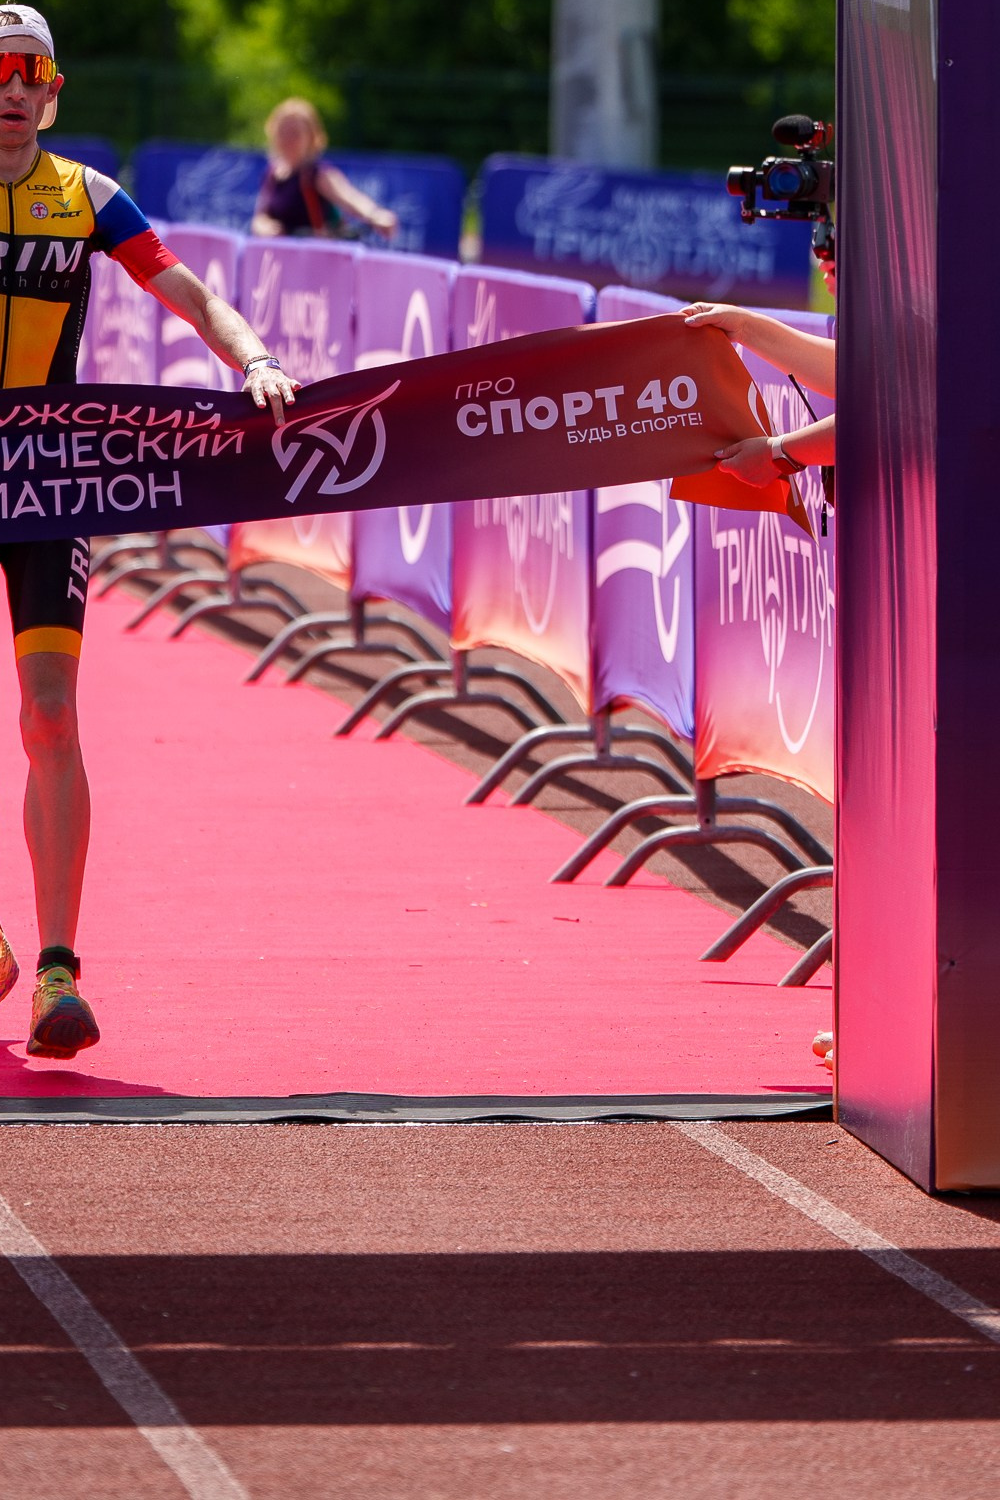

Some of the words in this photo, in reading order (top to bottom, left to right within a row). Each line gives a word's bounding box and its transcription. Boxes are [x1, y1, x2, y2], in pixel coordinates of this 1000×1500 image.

[455, 376, 516, 400] ПРО
[456, 385, 625, 437] СПОРТ
[636, 375, 698, 415] 40
[567, 425, 612, 444] БУДЬ
[615, 422, 628, 438] В
[630, 411, 703, 435] СПОРТЕ!
[67, 537, 89, 604] TRI
